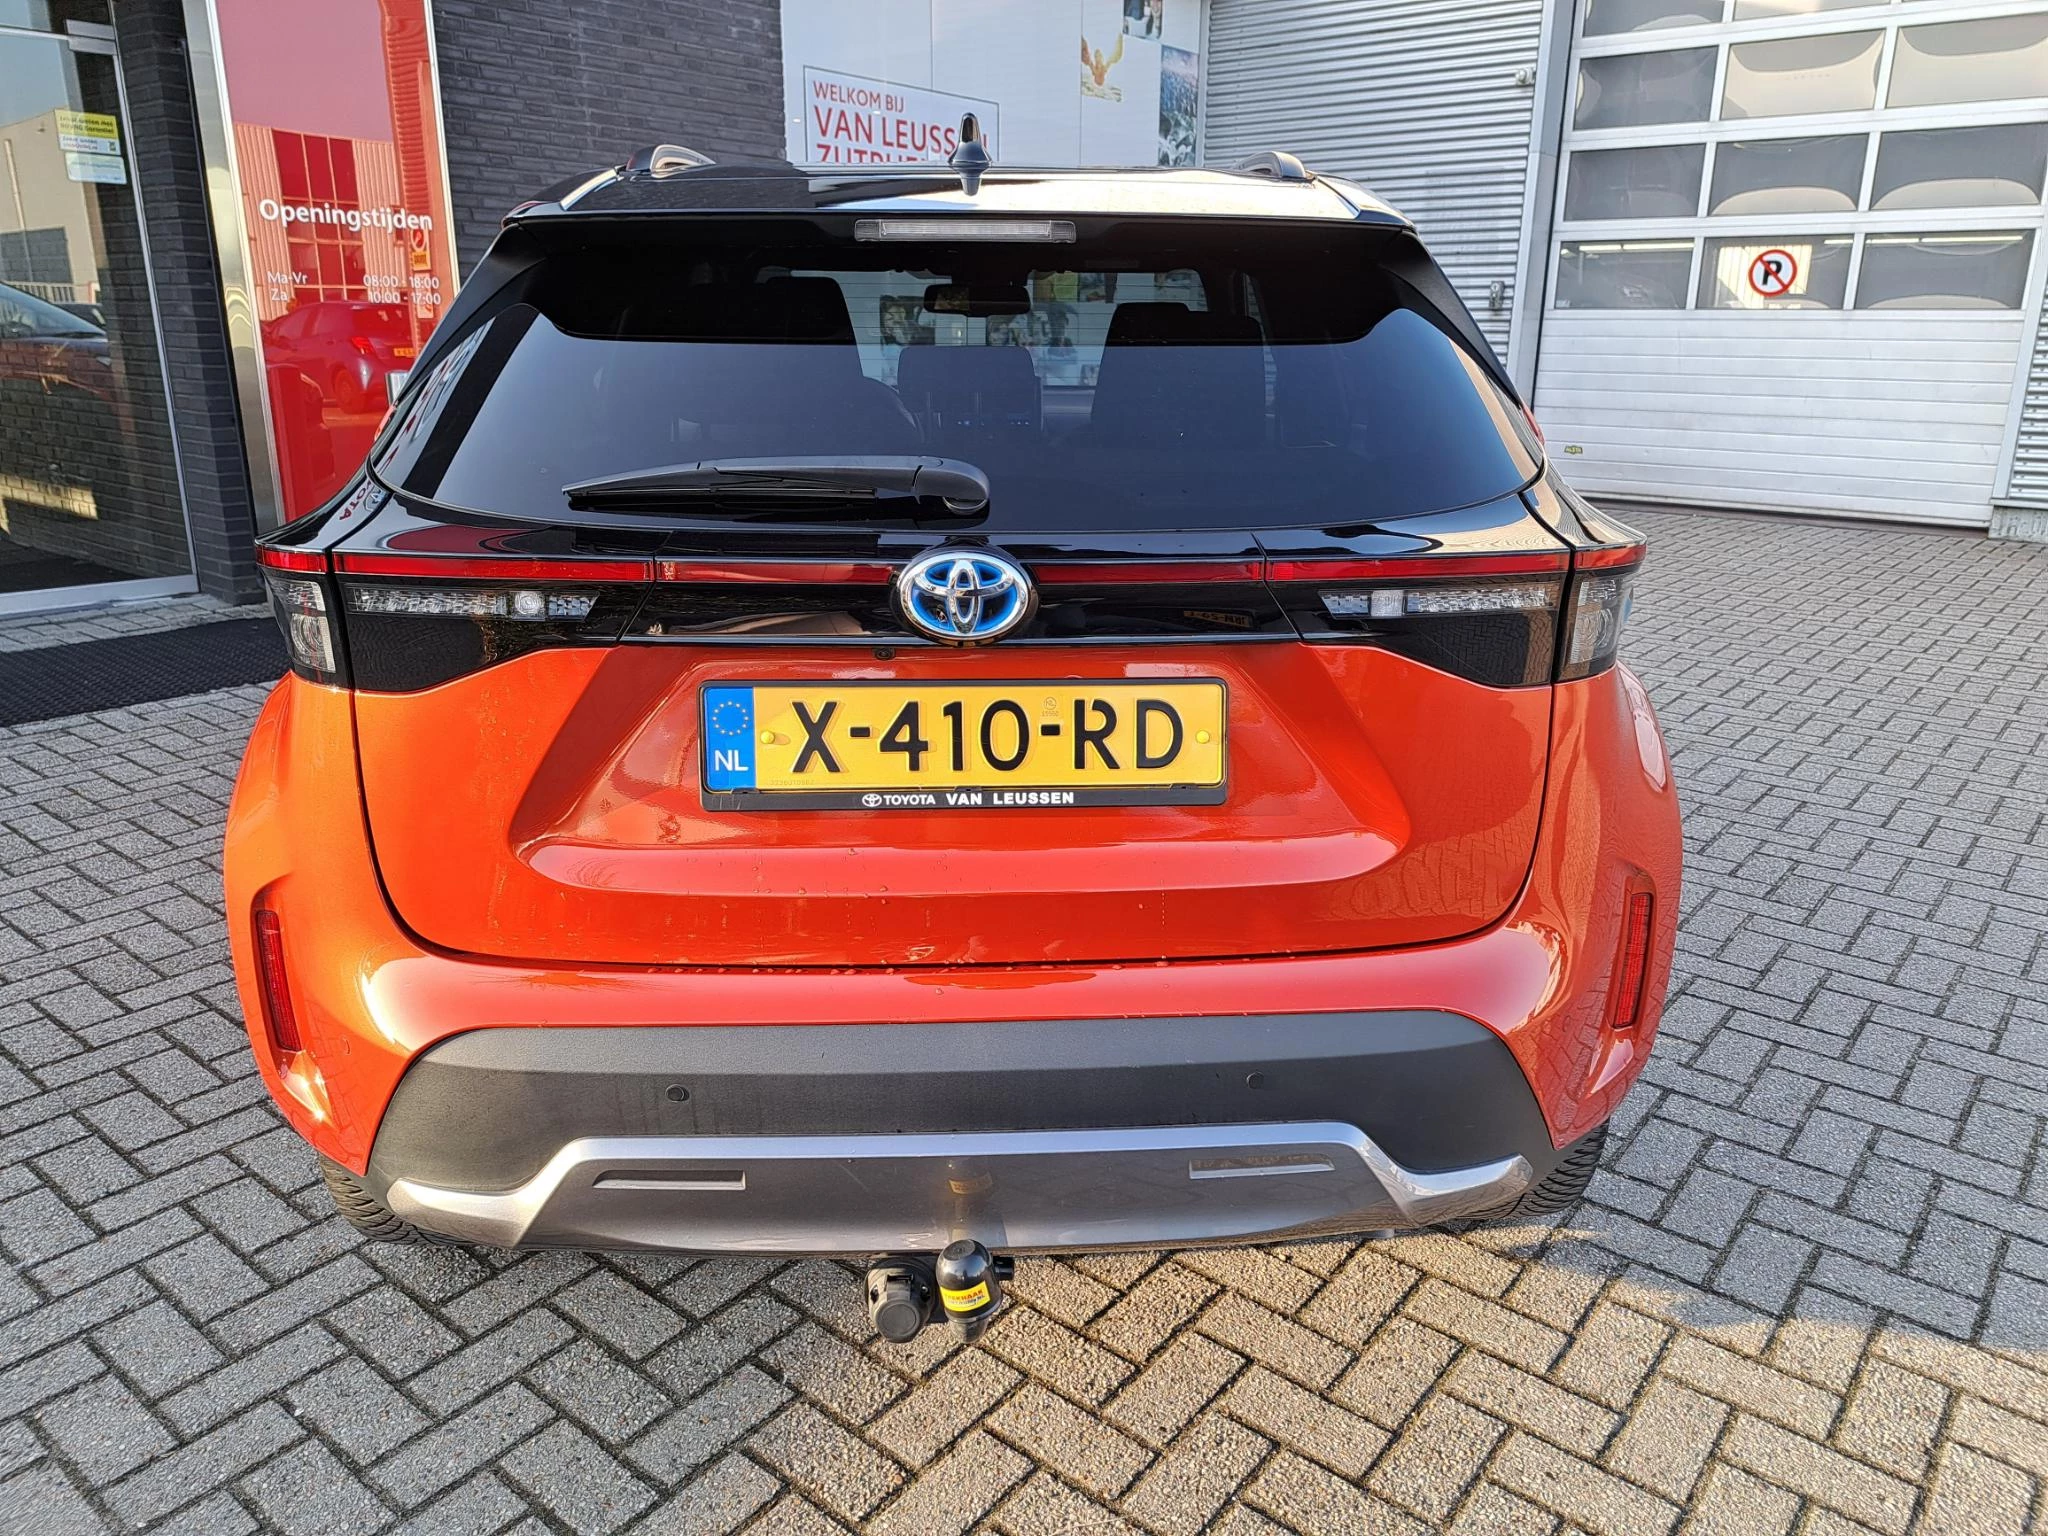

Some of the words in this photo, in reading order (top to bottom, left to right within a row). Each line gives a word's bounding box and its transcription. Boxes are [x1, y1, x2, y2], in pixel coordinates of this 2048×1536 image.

[812, 80, 881, 110] WELKOM
[885, 95, 905, 113] BIJ
[814, 105, 873, 145] VAN
[882, 116, 987, 155] LEUSS
[259, 199, 433, 233] Openingstijden
[267, 271, 308, 285] Ma-Vr
[363, 274, 399, 287] 08:00
[409, 276, 440, 289] 18:00
[1762, 260, 1782, 285] P
[271, 288, 289, 301] Za
[369, 291, 401, 304] 10:00
[412, 292, 441, 305] 17:00
[791, 698, 1184, 773] X-410-RD
[714, 749, 749, 772] NL
[883, 793, 936, 806] TOYOTA
[945, 792, 983, 806] VAN
[992, 791, 1075, 805] LEUSSEN
